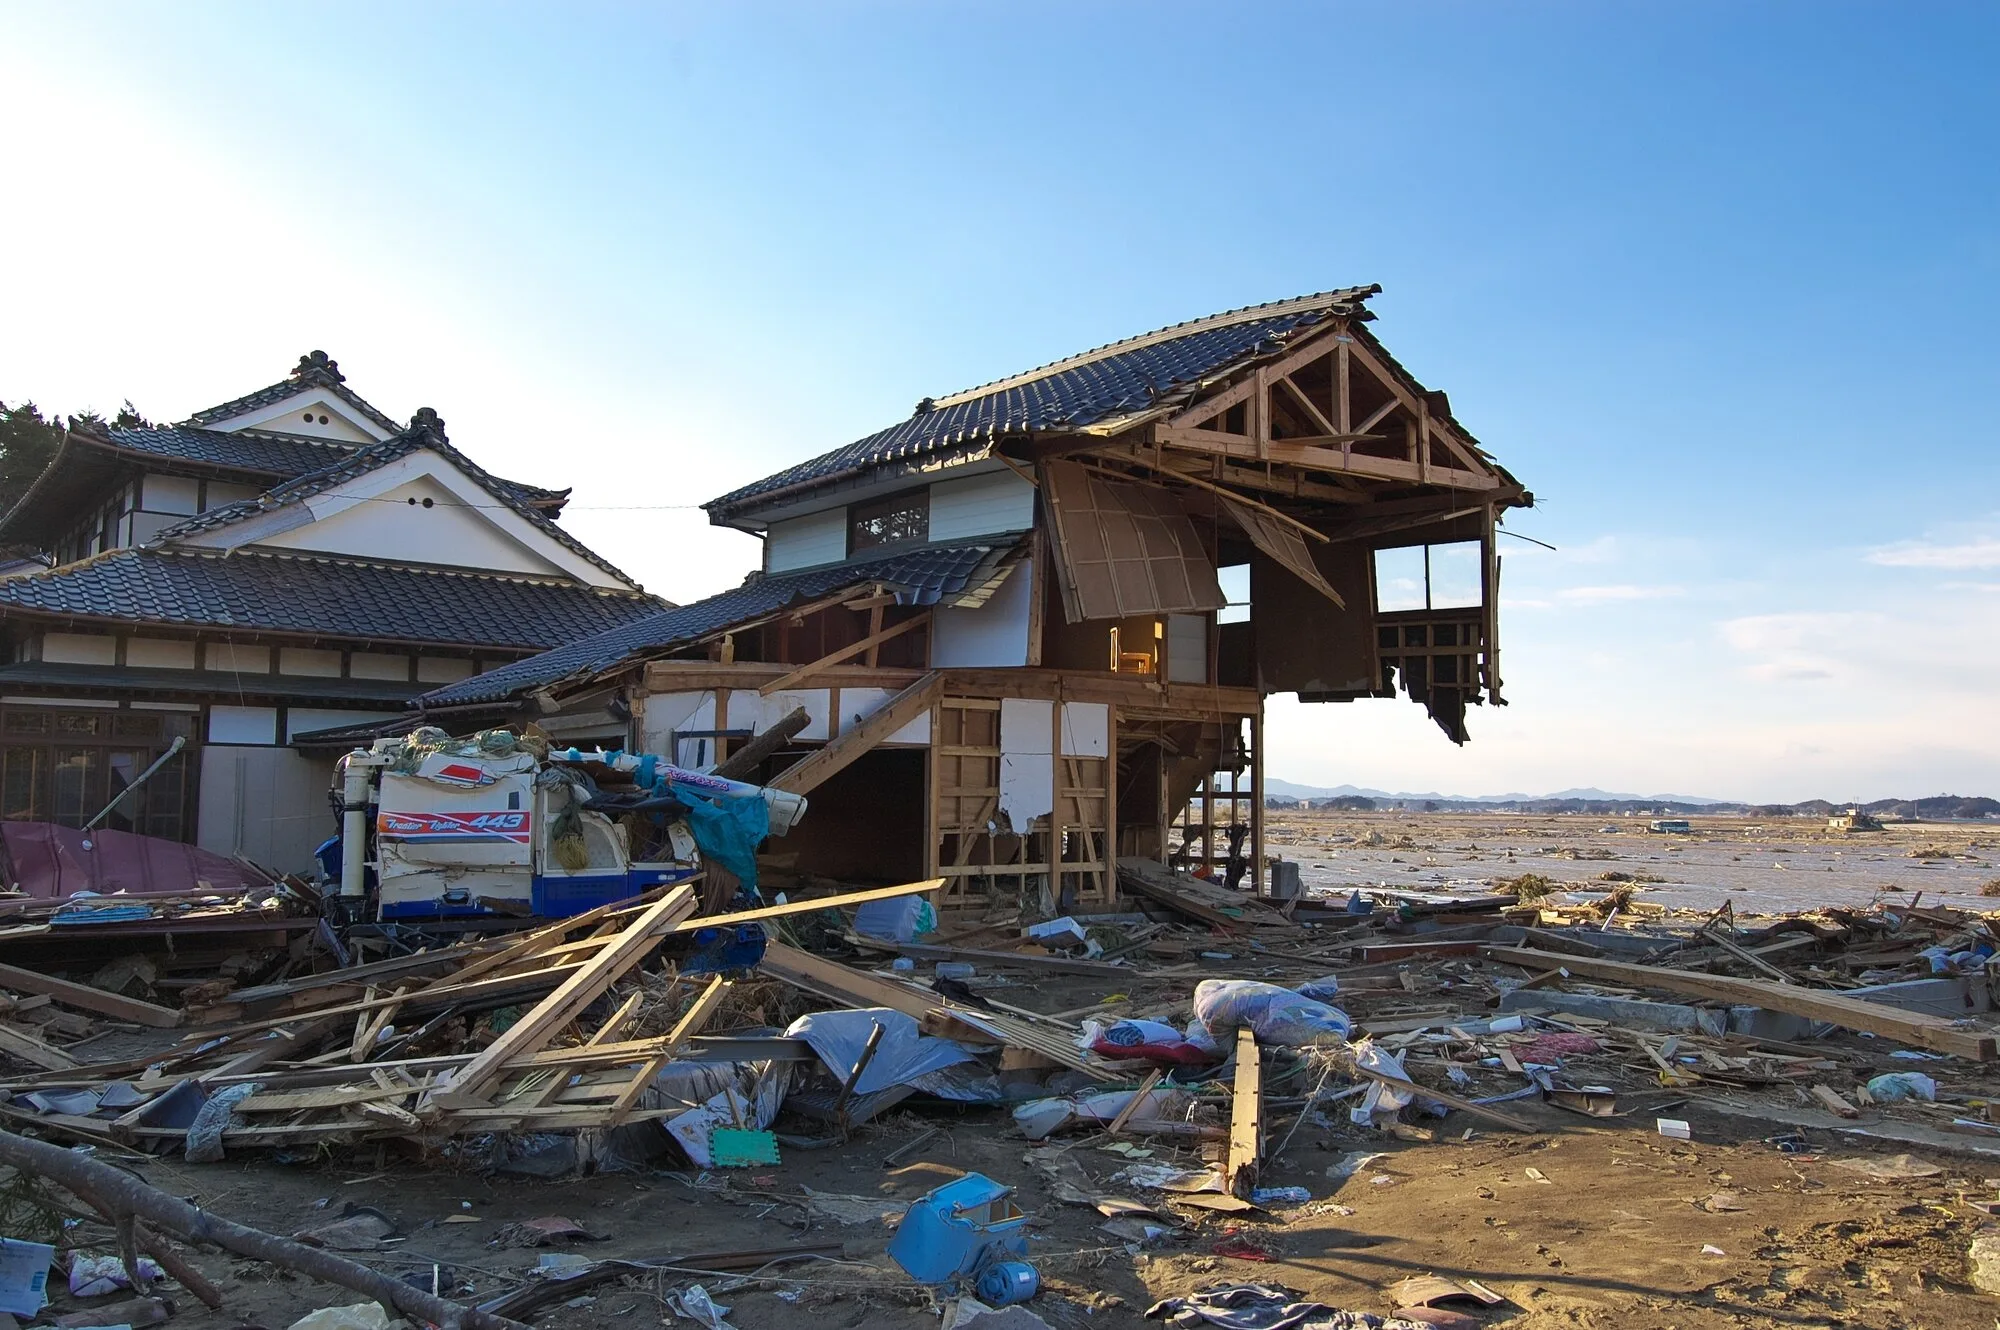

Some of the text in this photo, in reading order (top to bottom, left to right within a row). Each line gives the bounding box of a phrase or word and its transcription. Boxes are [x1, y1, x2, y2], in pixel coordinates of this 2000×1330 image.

[385, 813, 525, 831] Frontier Fighter 443
